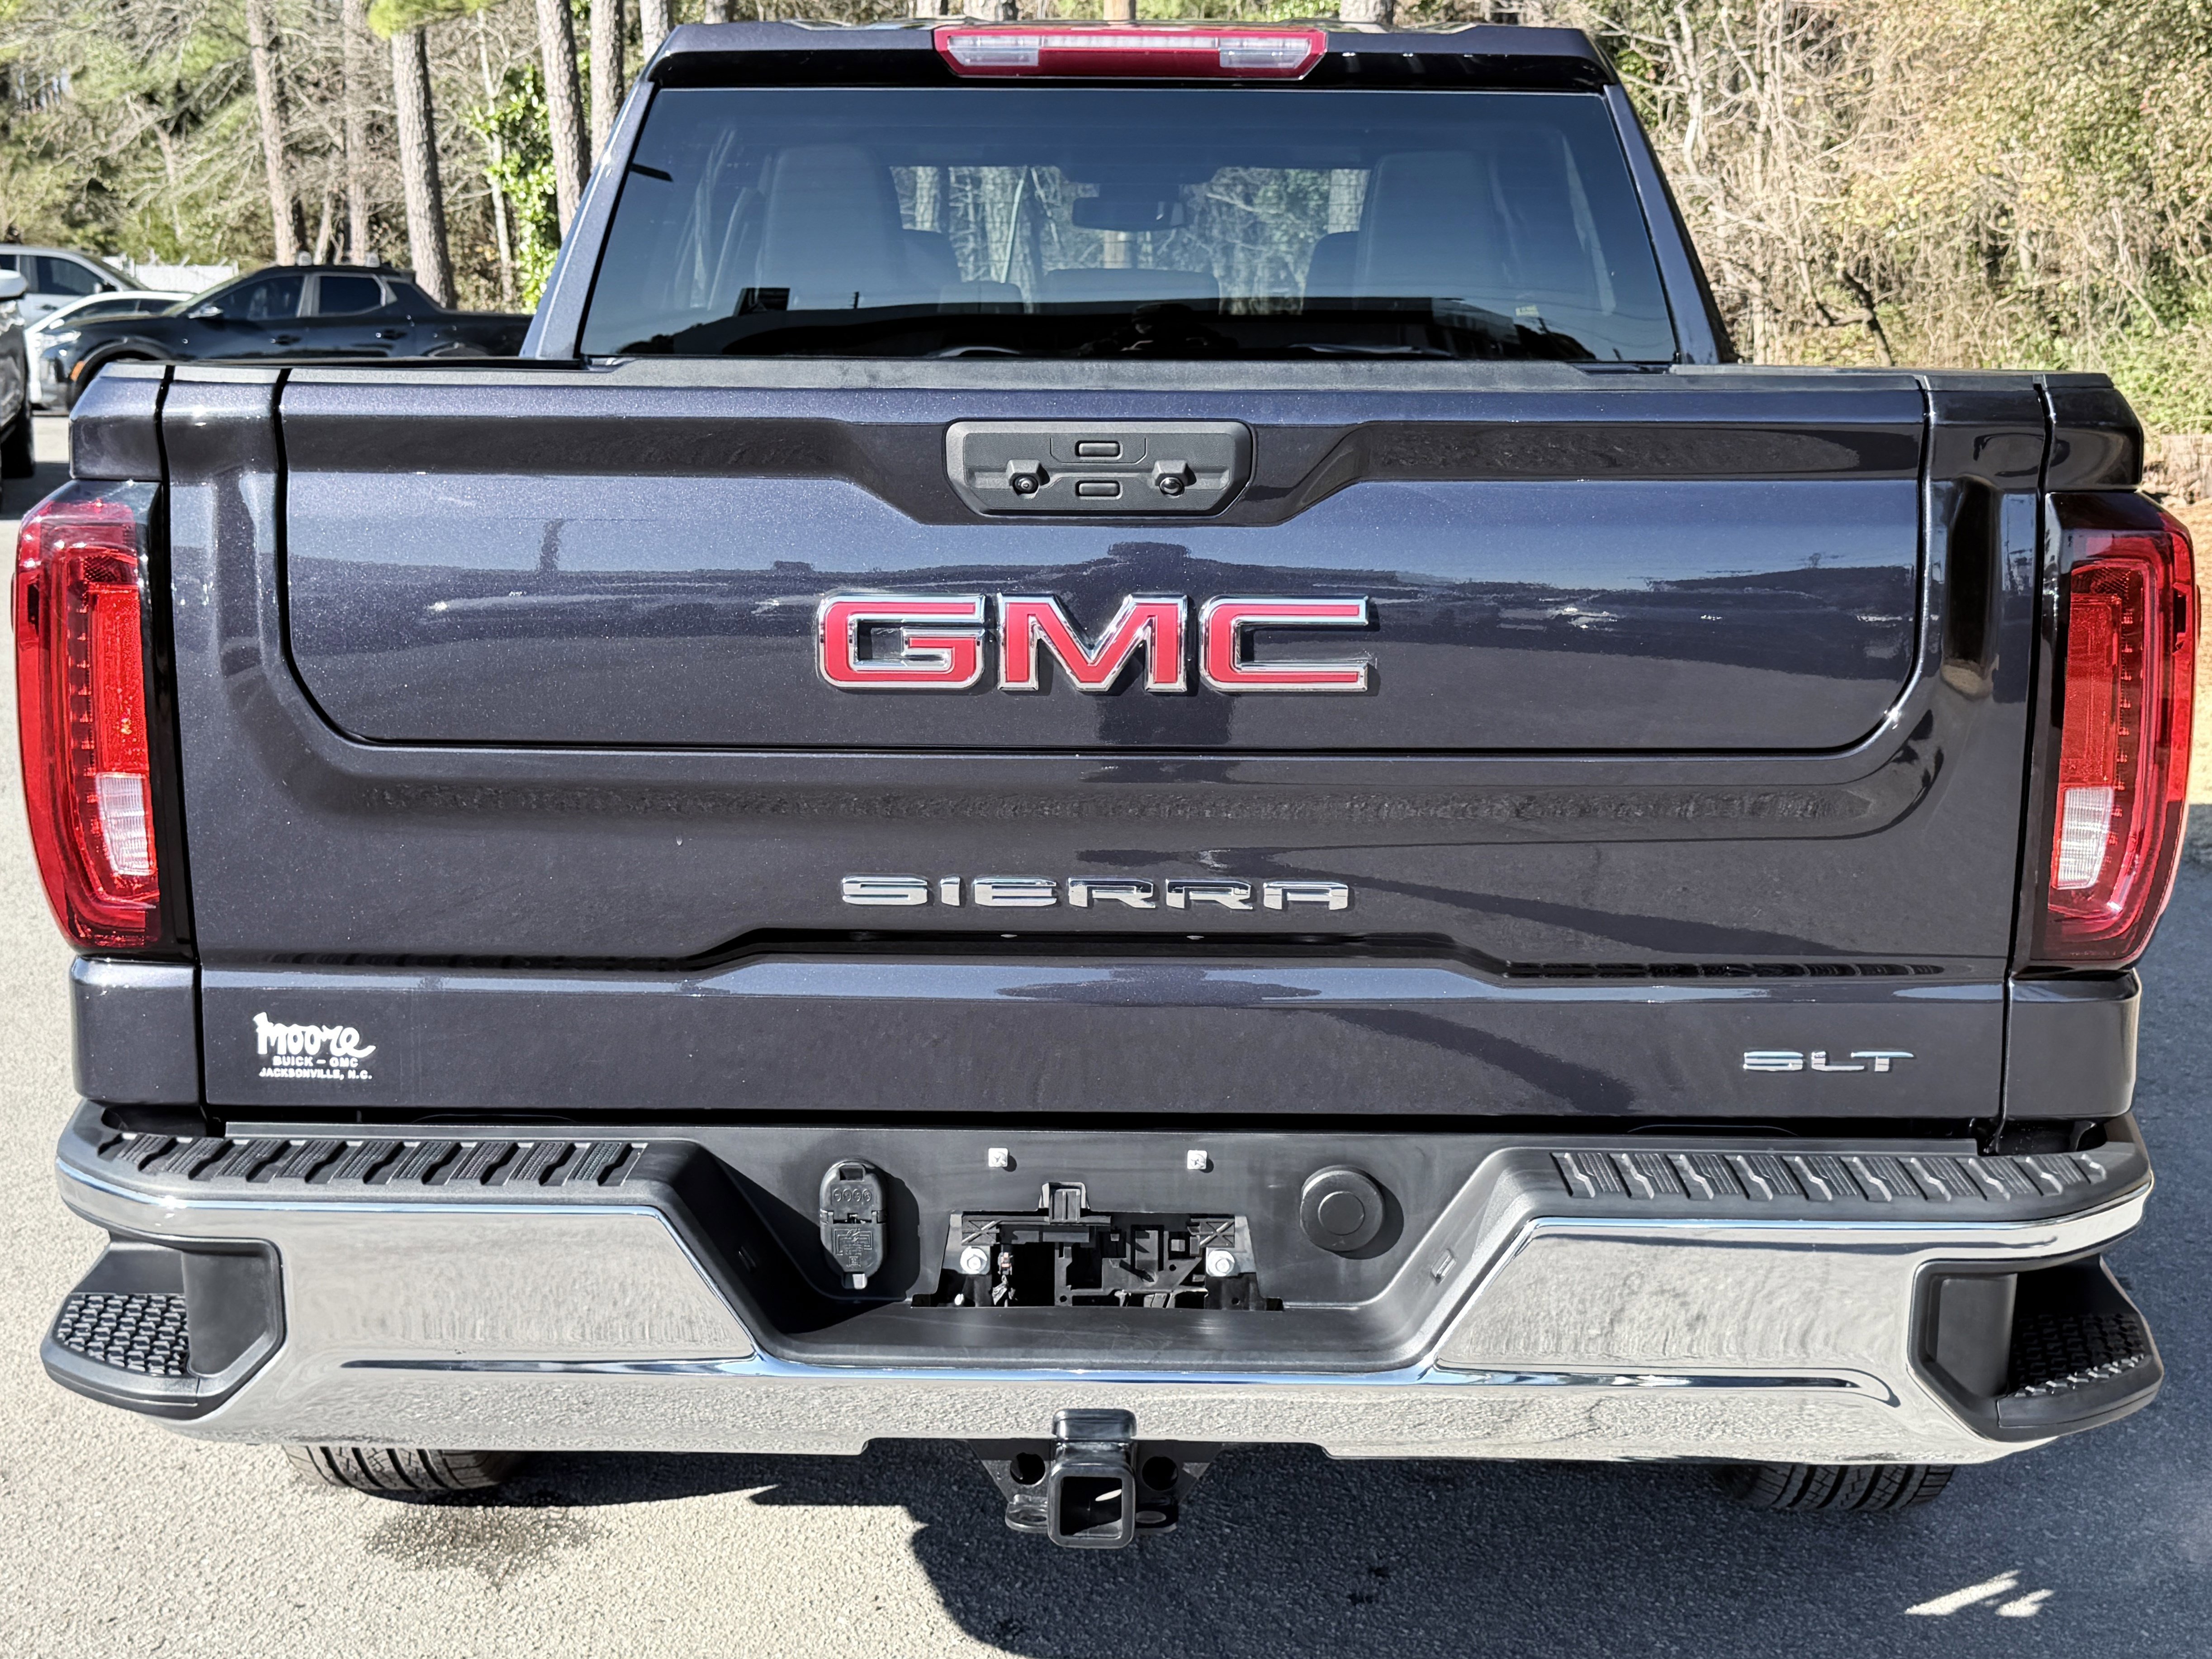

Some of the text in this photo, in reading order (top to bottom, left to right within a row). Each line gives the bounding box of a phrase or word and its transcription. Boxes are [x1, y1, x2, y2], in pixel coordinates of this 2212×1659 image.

[817, 593, 1369, 692] GMC
[842, 877, 1348, 910] SIERRA
[273, 1056, 313, 1066] BUICK
[330, 1057, 358, 1067] GMC
[1743, 1051, 1914, 1071] SLT
[259, 1067, 372, 1080] JACKSONVILLE, N.C.
